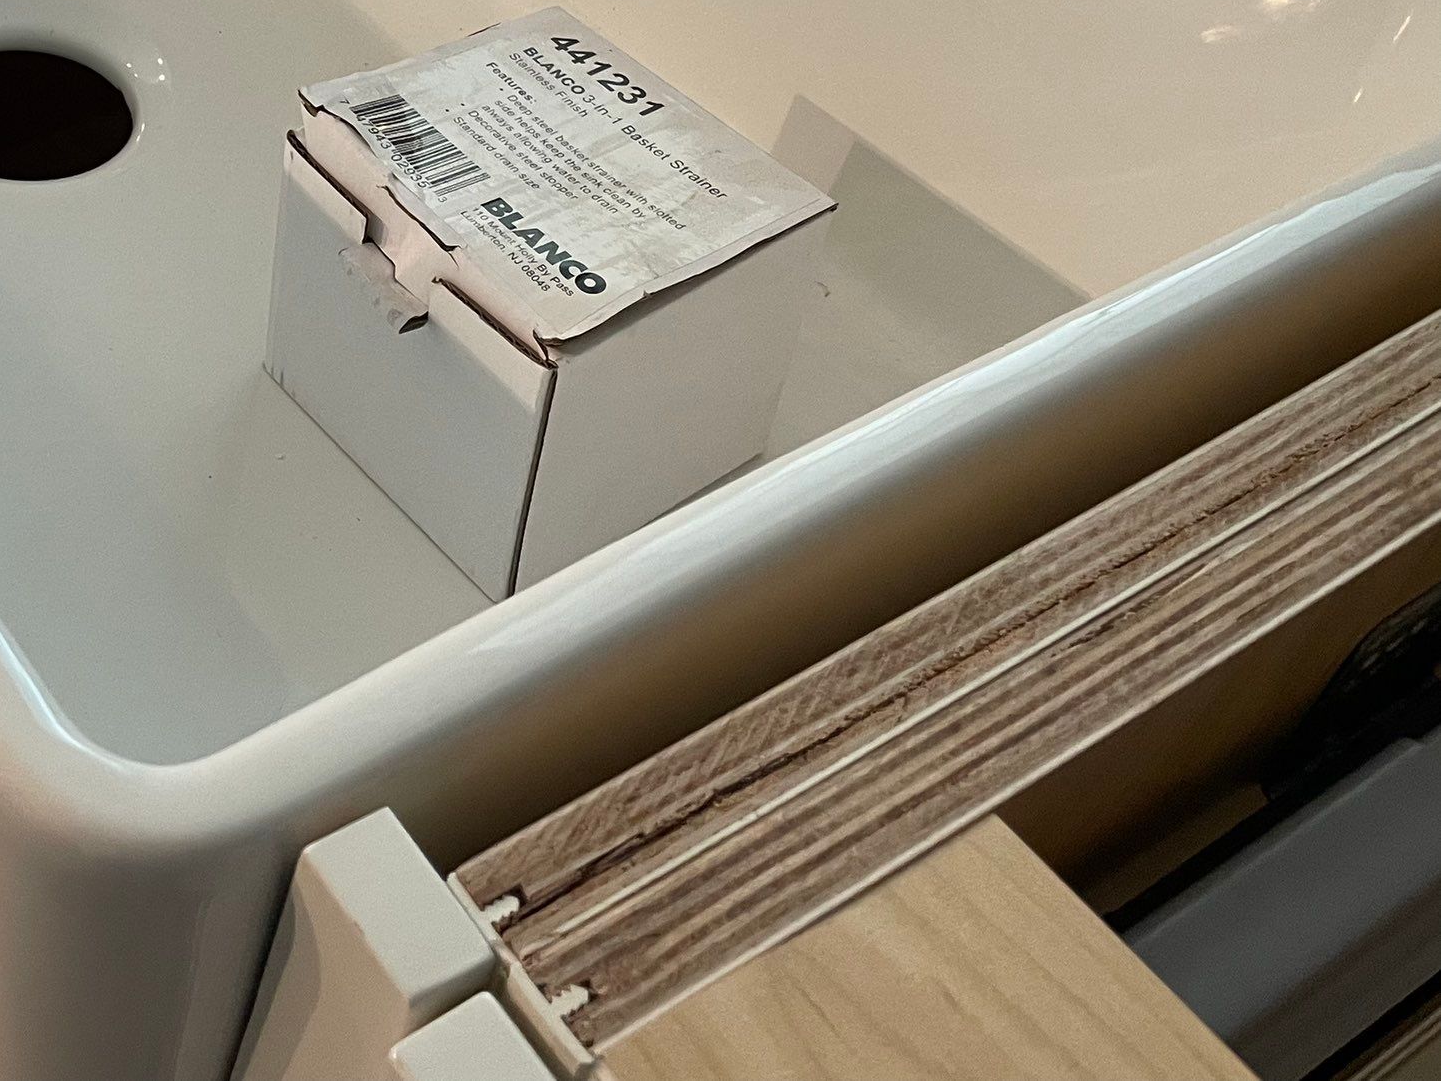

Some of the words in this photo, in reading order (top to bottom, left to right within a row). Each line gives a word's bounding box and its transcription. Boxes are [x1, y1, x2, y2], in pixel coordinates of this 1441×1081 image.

[486, 61, 538, 105] Features:
[509, 52, 557, 92] Stainless
[554, 90, 589, 119] Finish
[550, 36, 665, 117] 441231
[453, 116, 497, 152] Standard
[494, 152, 519, 173] drain
[519, 173, 540, 189] size
[468, 110, 517, 151] Decorative
[516, 152, 543, 171] steel
[540, 172, 578, 199] stopper
[481, 105, 514, 132] always
[513, 132, 552, 164] allowing
[552, 163, 581, 185] water
[579, 185, 592, 195] to
[591, 194, 618, 214] drain
[494, 100, 515, 117] side
[515, 116, 541, 139] helps
[540, 138, 565, 159] keep
[564, 158, 582, 172] the
[581, 172, 604, 189] sink
[603, 187, 632, 209] clean
[631, 207, 646, 218] by
[507, 94, 533, 116] Deep
[532, 116, 558, 136] steel
[555, 135, 589, 162] basket
[588, 161, 627, 189] strainer
[626, 188, 648, 205] with
[648, 204, 687, 230] slotted
[523, 46, 585, 95] BLANCO
[620, 125, 671, 161] Basket
[669, 159, 728, 200] Strainer
[391, 153, 431, 188] 02935
[472, 207, 488, 221] 110
[487, 221, 516, 245] Mount
[515, 243, 538, 265] Holly
[550, 276, 574, 297] Pass
[480, 197, 607, 295] BLANCO
[508, 252, 523, 265] NJ
[521, 265, 551, 292] 08048
